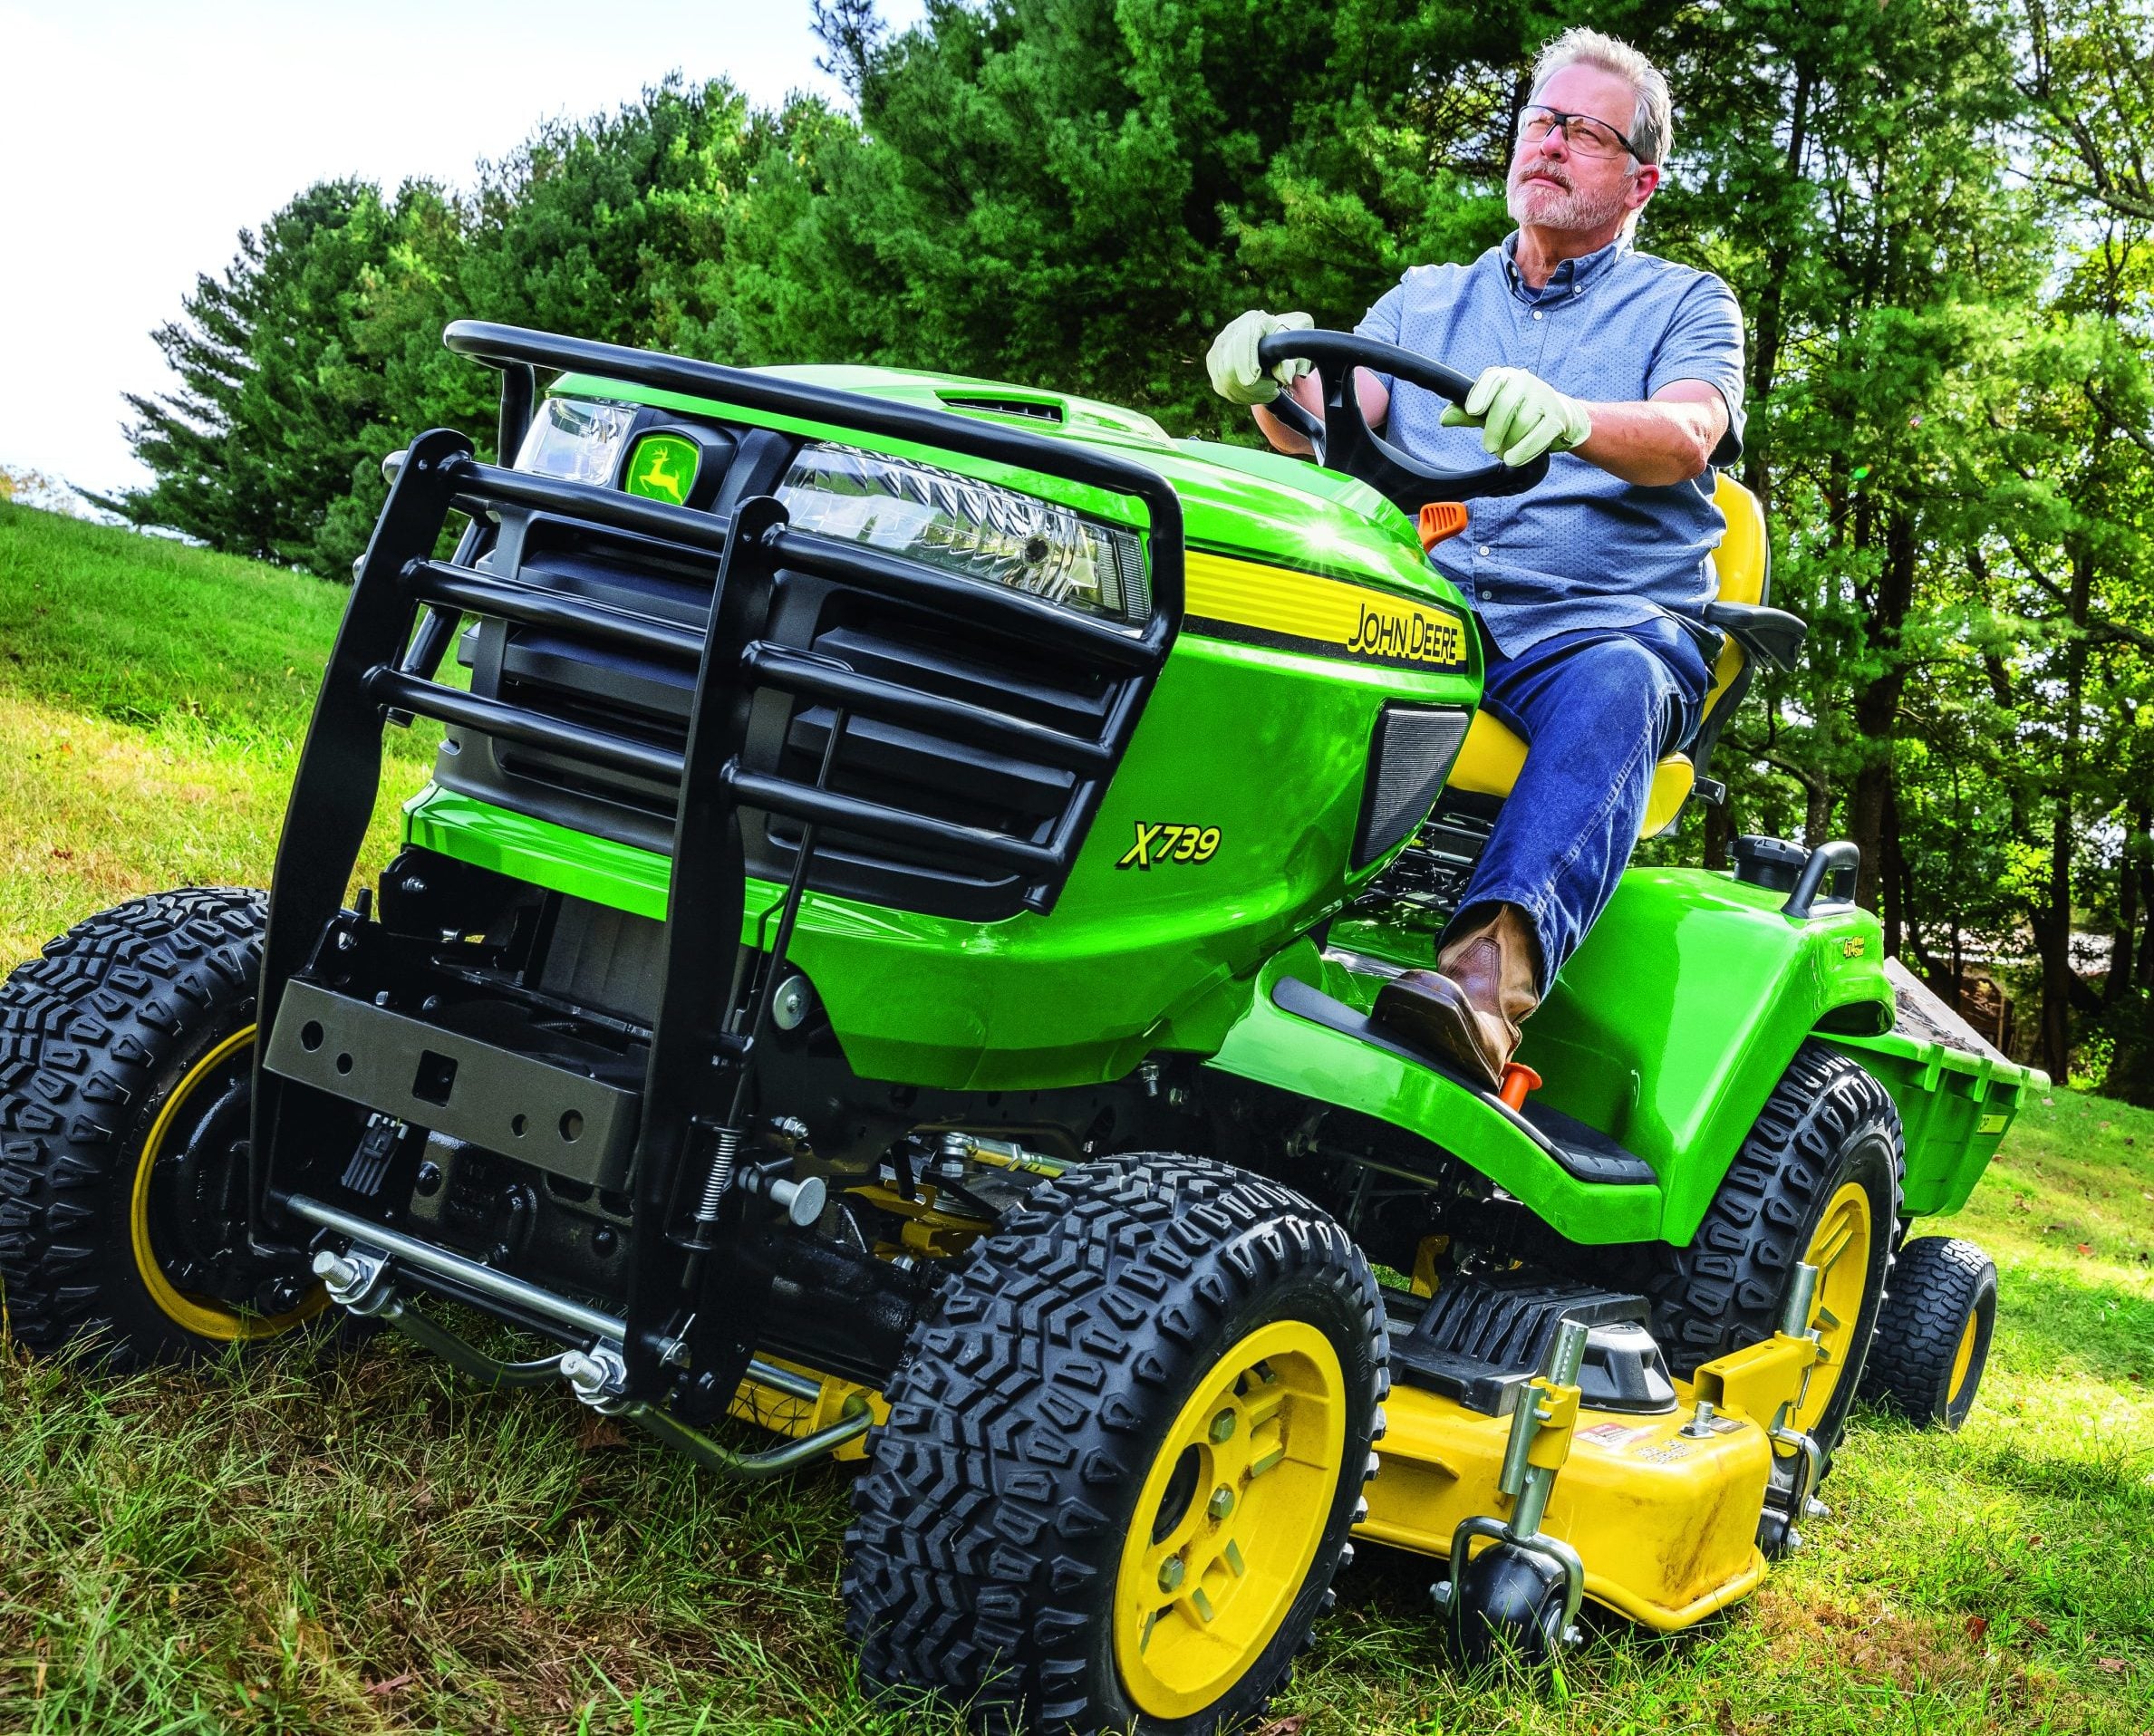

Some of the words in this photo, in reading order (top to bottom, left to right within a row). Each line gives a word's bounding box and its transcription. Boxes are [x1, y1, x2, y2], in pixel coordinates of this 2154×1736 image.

[1348, 603, 1408, 654] JOHN
[1410, 612, 1458, 661] DEERE
[1116, 820, 1222, 872] X739
